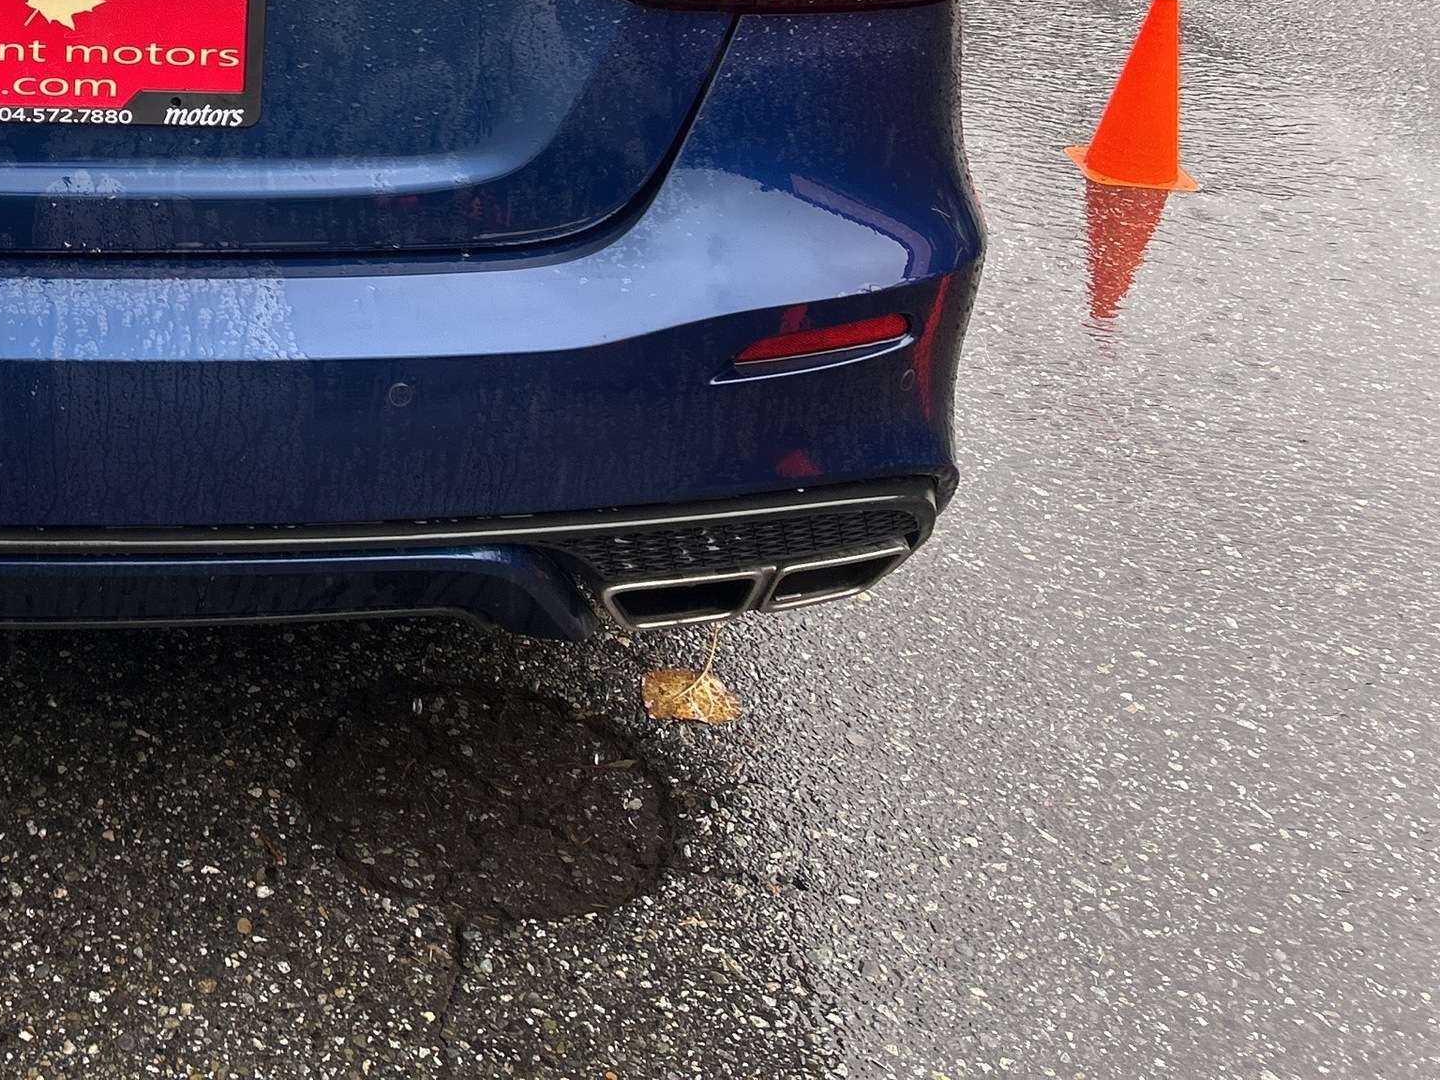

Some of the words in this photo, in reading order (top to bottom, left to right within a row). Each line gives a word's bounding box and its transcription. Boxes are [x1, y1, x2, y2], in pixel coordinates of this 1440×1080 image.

[64, 43, 240, 67] motors
[0, 76, 118, 98] .com
[163, 103, 245, 127] motors
